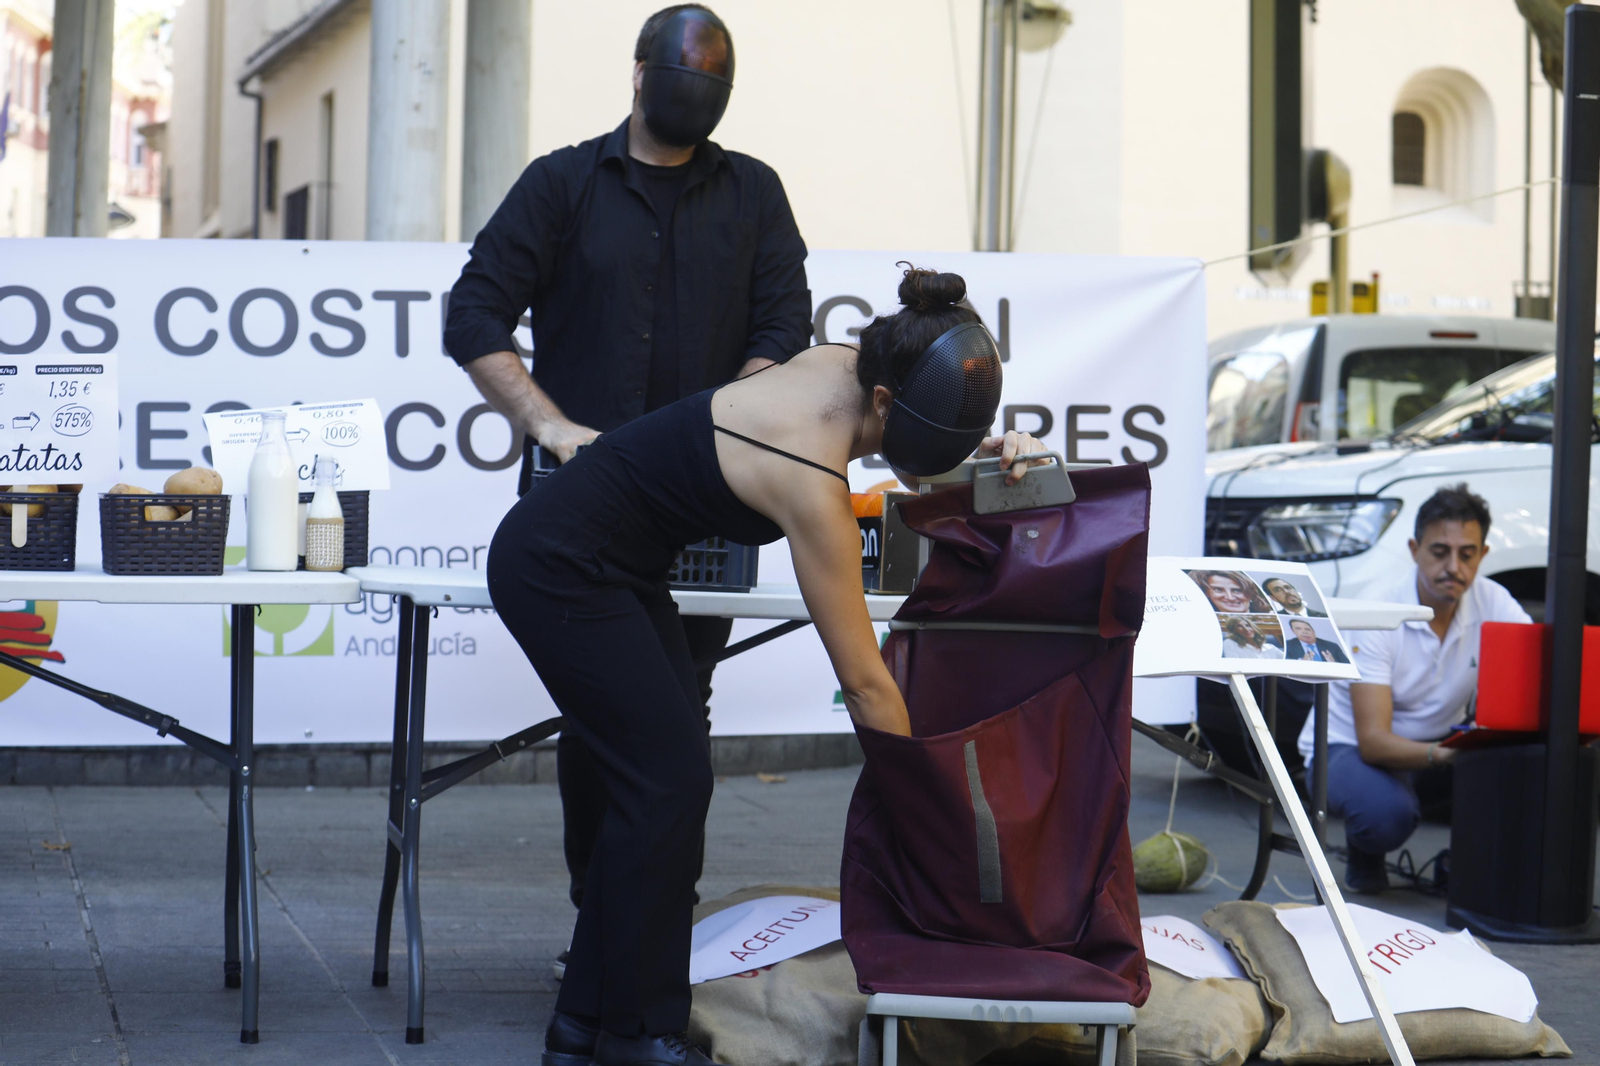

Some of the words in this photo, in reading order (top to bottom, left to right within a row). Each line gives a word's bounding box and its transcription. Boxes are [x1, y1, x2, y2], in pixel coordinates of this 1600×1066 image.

[83, 366, 102, 374] (€/kg)
[49, 380, 78, 399] 1,35
[83, 381, 92, 395] €
[54, 411, 92, 428] 575%
[312, 410, 344, 419] 0,80
[325, 425, 359, 439] 100%
[1367, 929, 1436, 975] TRIGO
